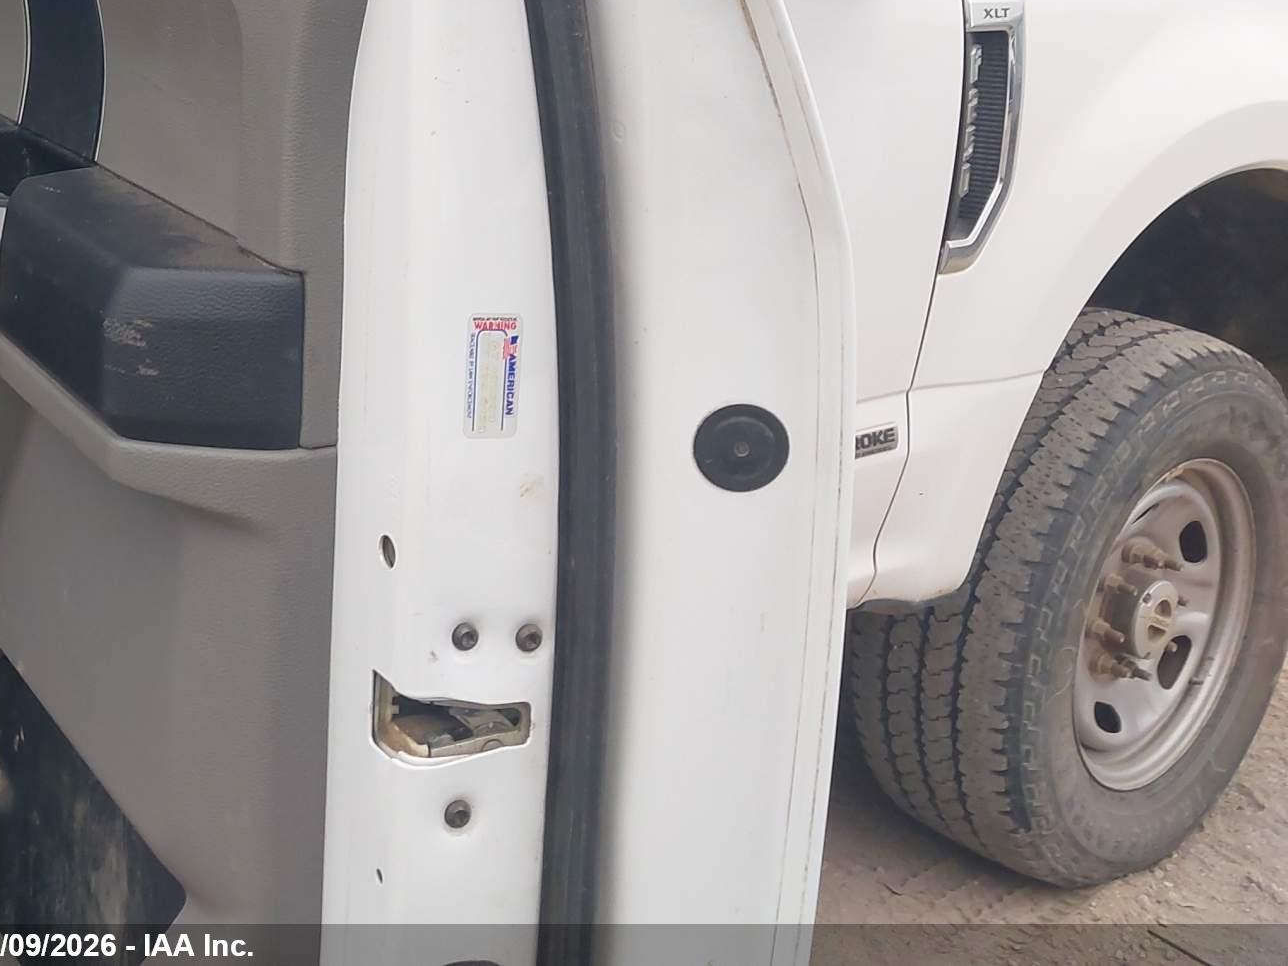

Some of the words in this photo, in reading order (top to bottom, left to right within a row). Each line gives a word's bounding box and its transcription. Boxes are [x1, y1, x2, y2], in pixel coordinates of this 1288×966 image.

[983, 7, 1011, 19] XLT
[473, 321, 517, 331] WARNING
[505, 353, 517, 416] AMERICAN
